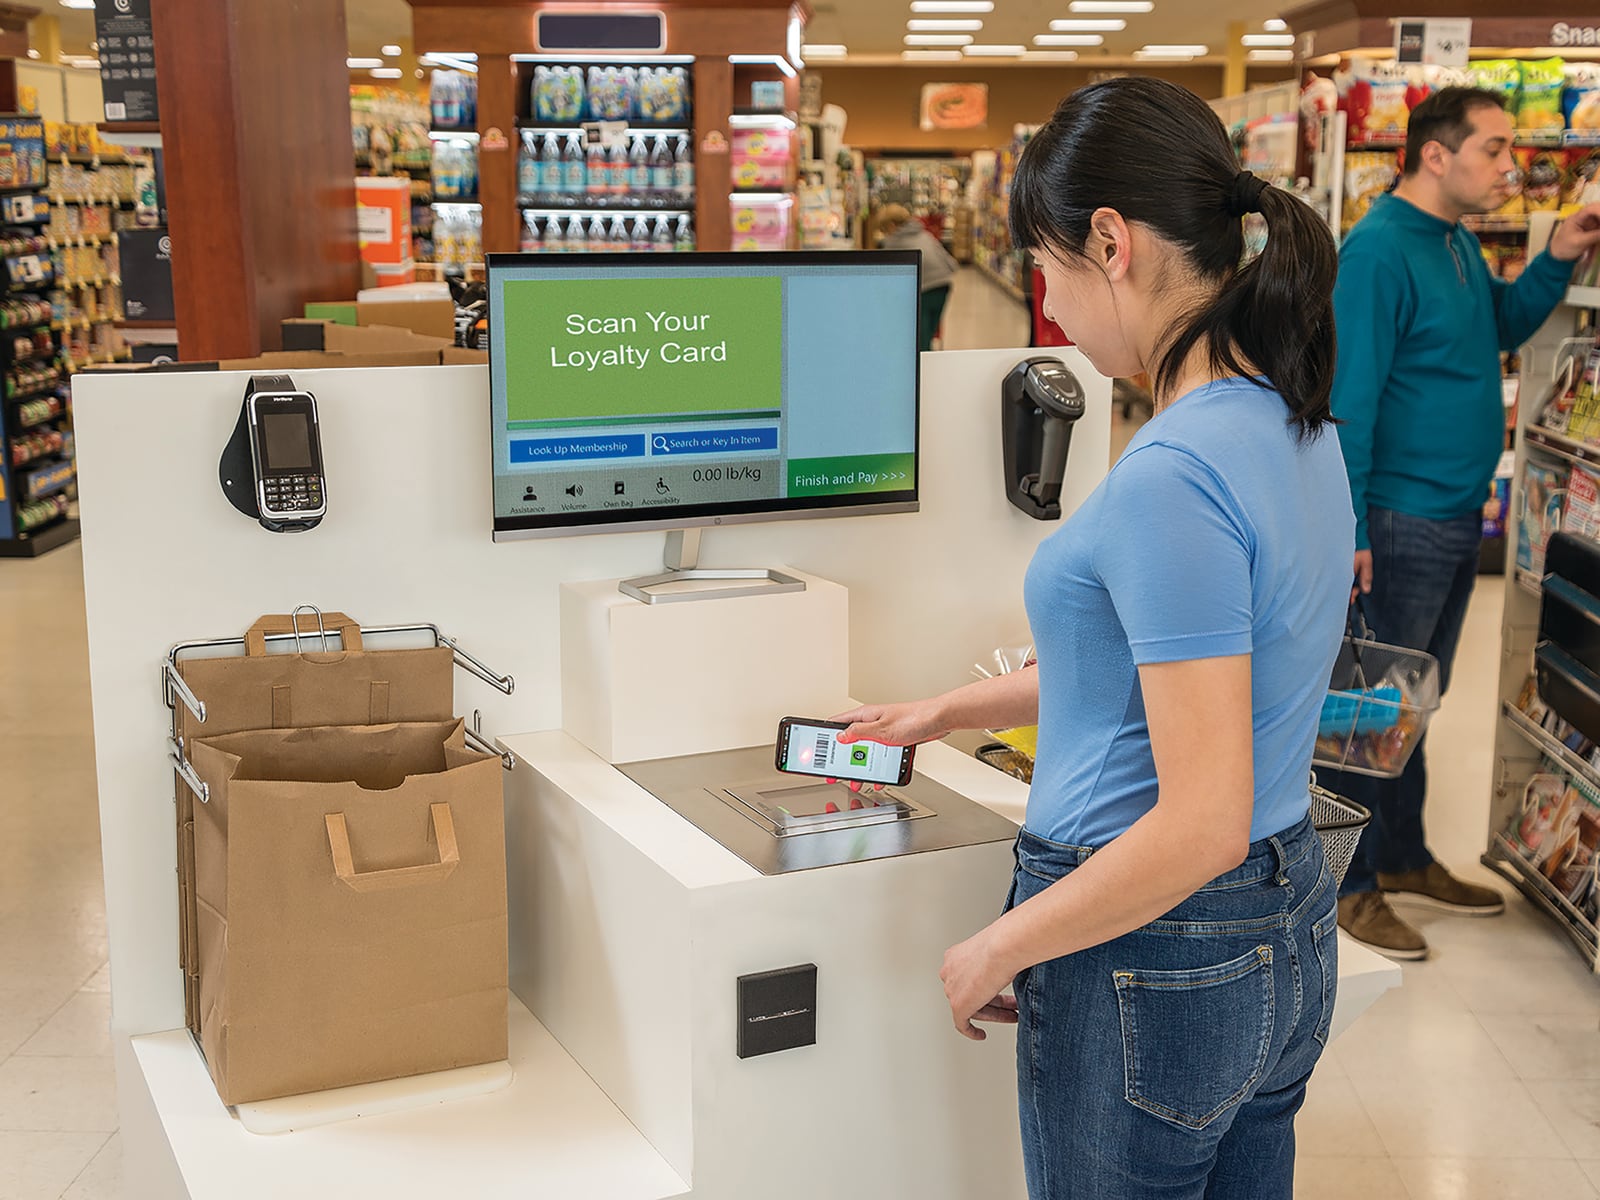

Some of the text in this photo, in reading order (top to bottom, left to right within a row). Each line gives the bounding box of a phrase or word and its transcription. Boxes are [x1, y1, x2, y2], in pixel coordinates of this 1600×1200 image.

[565, 311, 710, 335] Scan Your
[550, 340, 727, 372] Loyalty Card
[528, 441, 628, 456] Look Up Membership
[669, 435, 761, 449] Search or Key In Item
[692, 466, 761, 482] 0.00 lb/kg
[795, 473, 829, 487] Finish
[832, 471, 854, 484] and
[858, 471, 878, 485] Pay
[560, 502, 588, 511] Volume
[603, 500, 634, 509] Own Bag
[641, 495, 681, 506] Accessibility
[510, 505, 546, 514] Assistance
